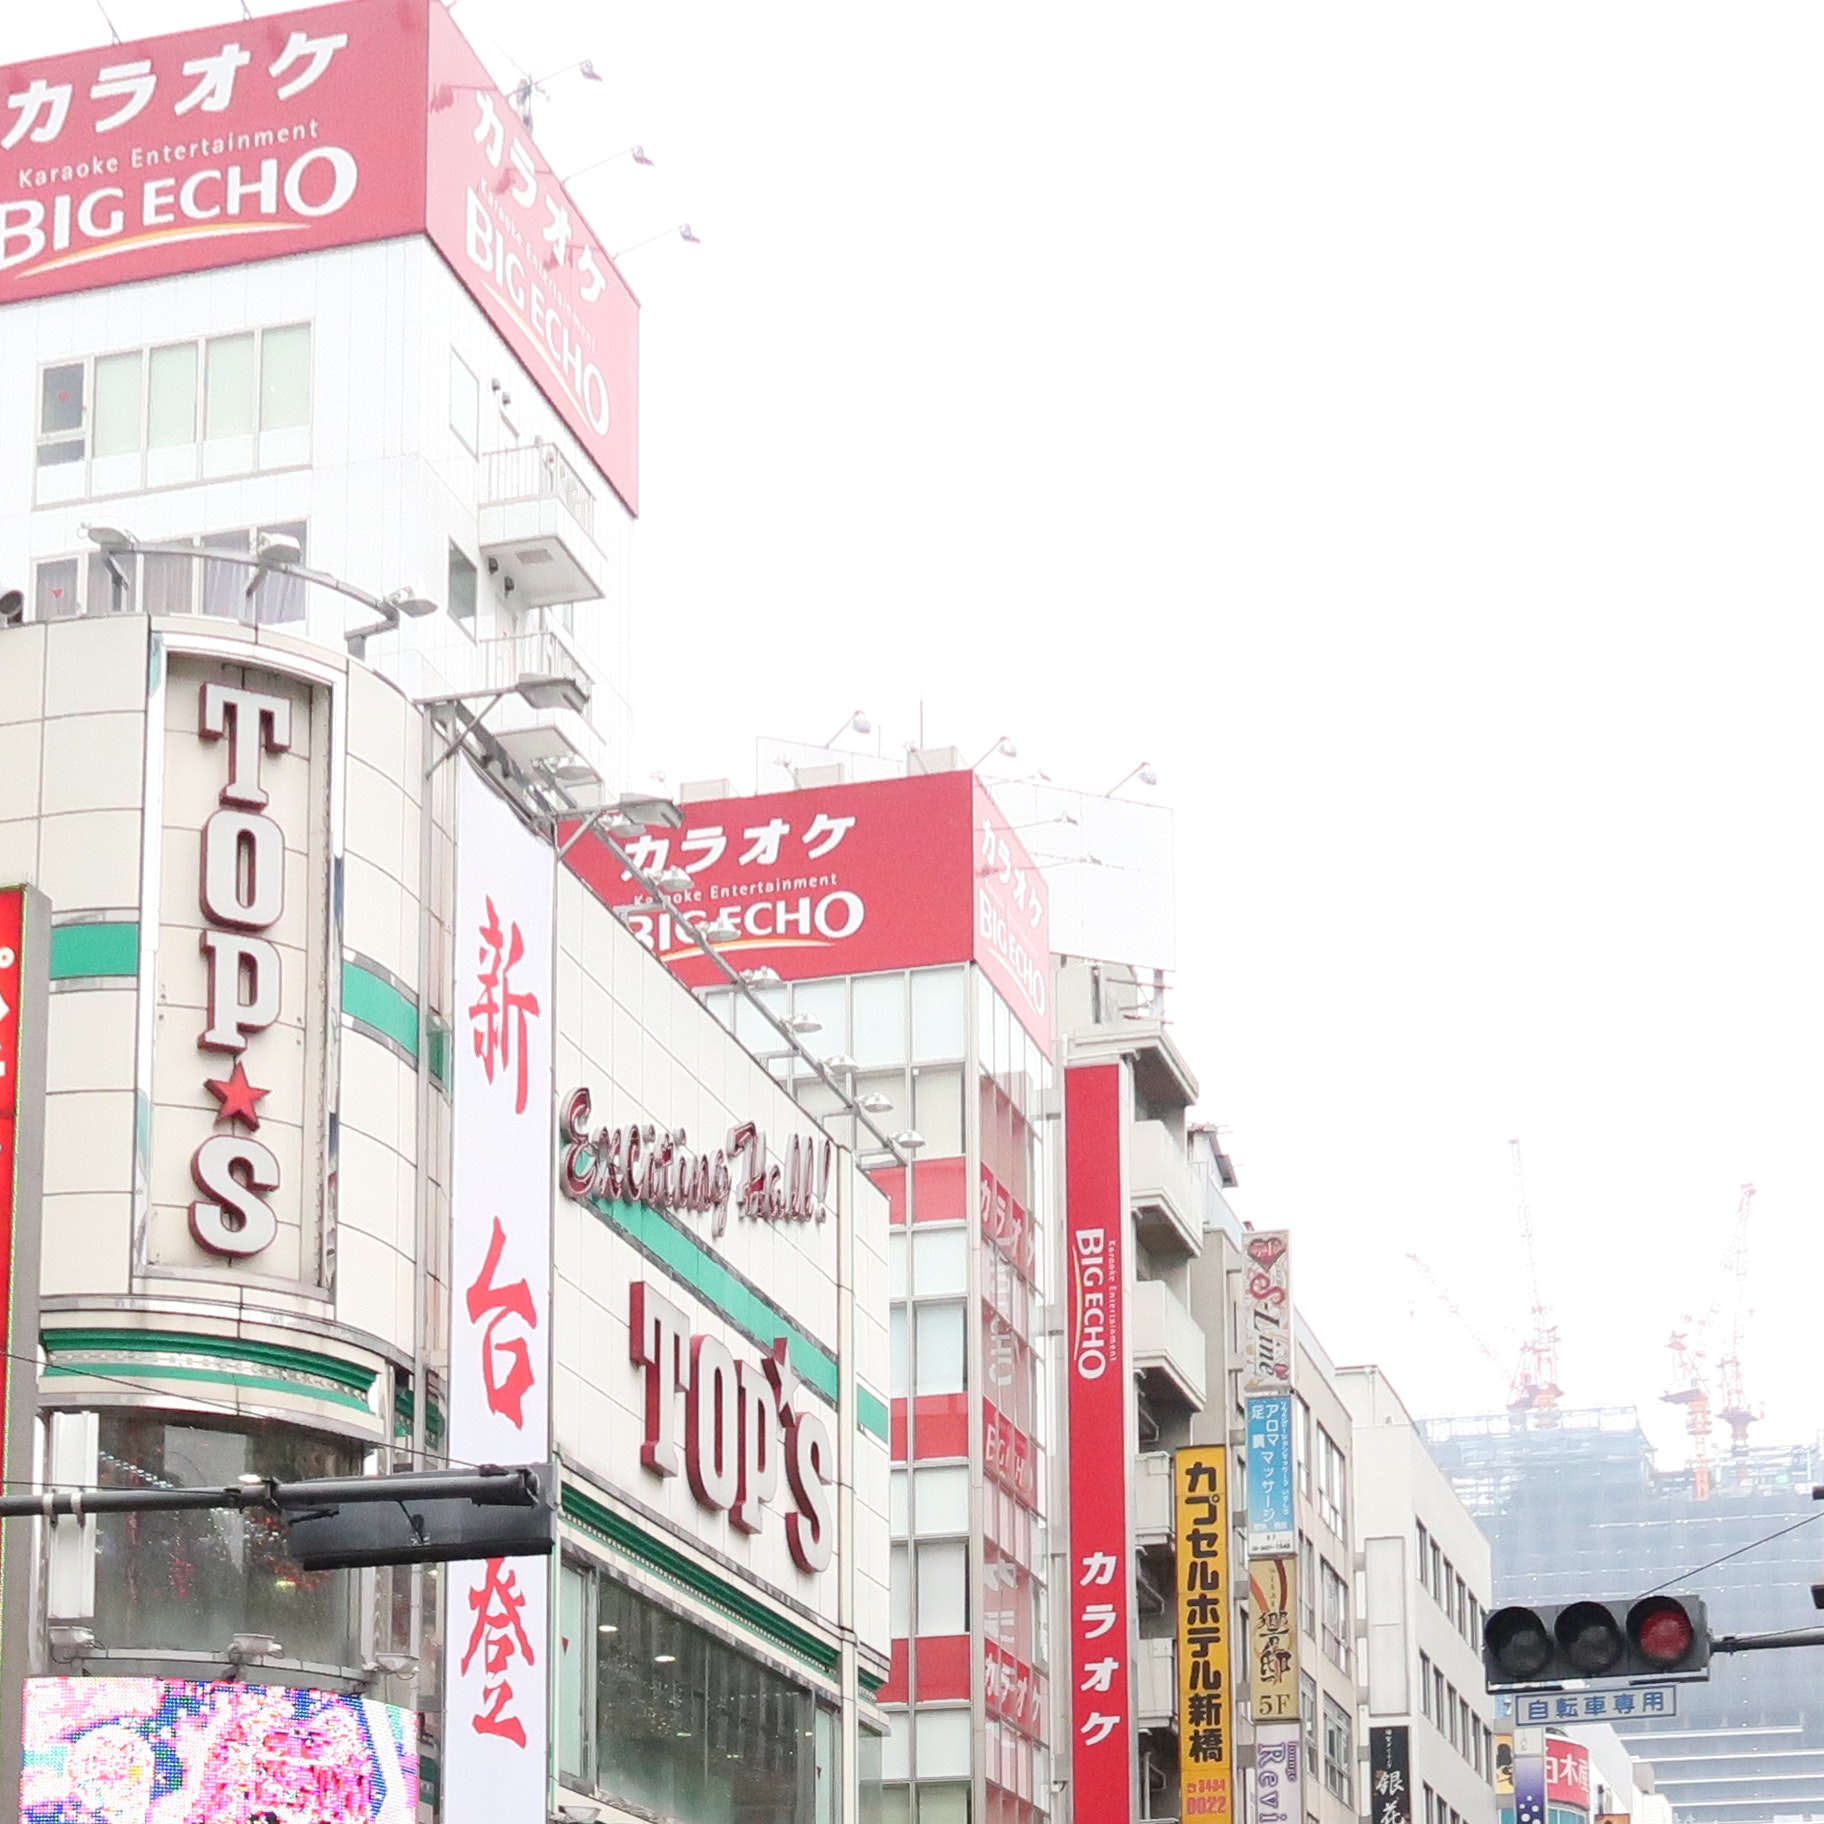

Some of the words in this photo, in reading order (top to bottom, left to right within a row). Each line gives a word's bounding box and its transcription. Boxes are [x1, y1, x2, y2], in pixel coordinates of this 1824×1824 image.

[0, 30, 348, 151] カラオケ
[18, 155, 119, 188] Karaoke
[130, 121, 318, 170] Entertainment
[142, 146, 358, 224] ECHO
[473, 91, 607, 303] カラオケ
[466, 185, 527, 312] BIG
[531, 281, 609, 437] ECHO
[620, 813, 856, 882] カラオケ
[633, 888, 702, 908] Kaaoke
[710, 873, 837, 901] Entertainment
[979, 887, 1008, 953] BIG
[1009, 936, 1045, 1017] ECHO
[560, 1087, 731, 1238] Exciting
[1075, 1228, 1106, 1286] BIG
[1077, 1293, 1106, 1380] ECHO
[1080, 1552, 1120, 1746] カラオケ
[1184, 1460, 1224, 1764] カプセルホテル新橋
[1259, 1695, 1291, 1715] 5F
[1527, 1692, 1665, 1721] 自転車専用
